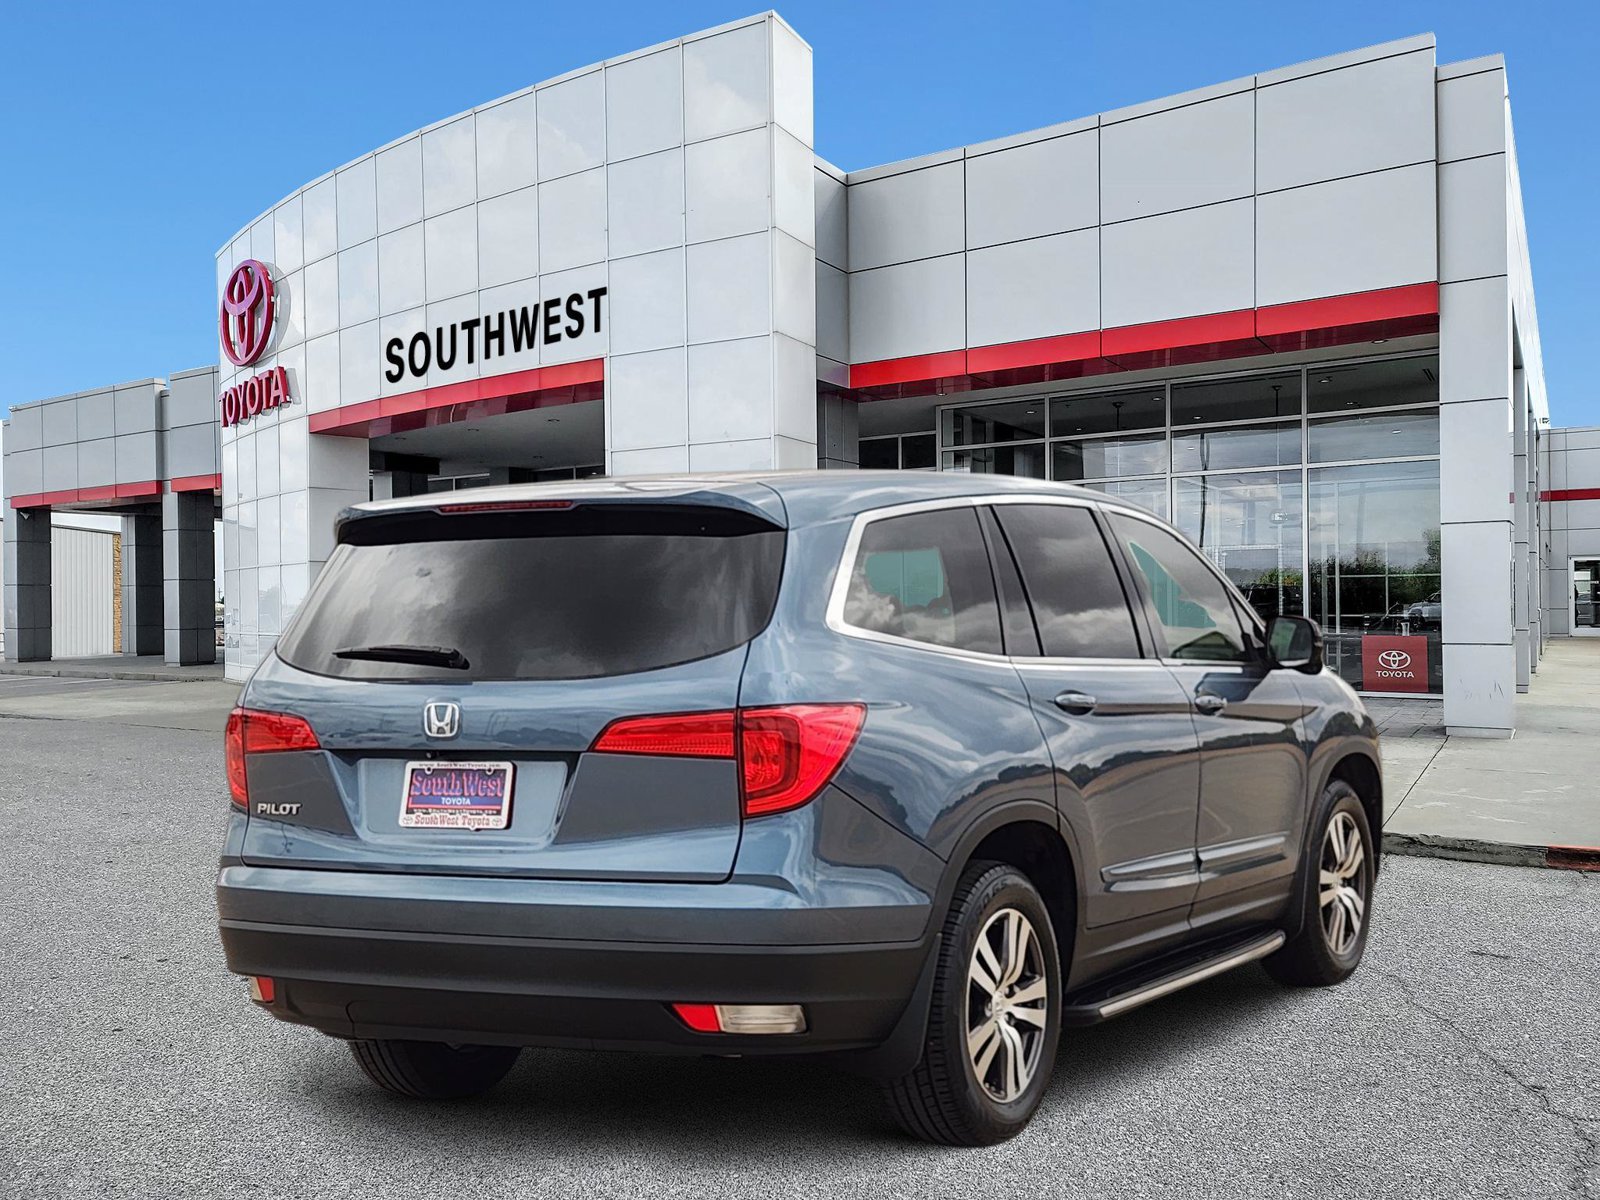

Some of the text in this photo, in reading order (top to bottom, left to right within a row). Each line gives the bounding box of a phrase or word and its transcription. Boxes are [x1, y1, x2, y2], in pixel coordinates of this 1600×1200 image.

[385, 287, 608, 384] SOUTHWEST
[219, 366, 291, 428] TOYOTA
[1375, 670, 1415, 678] TOYOTA
[441, 797, 471, 805] TOYOTA
[257, 802, 301, 815] PILOT
[461, 815, 490, 827] Toyota
